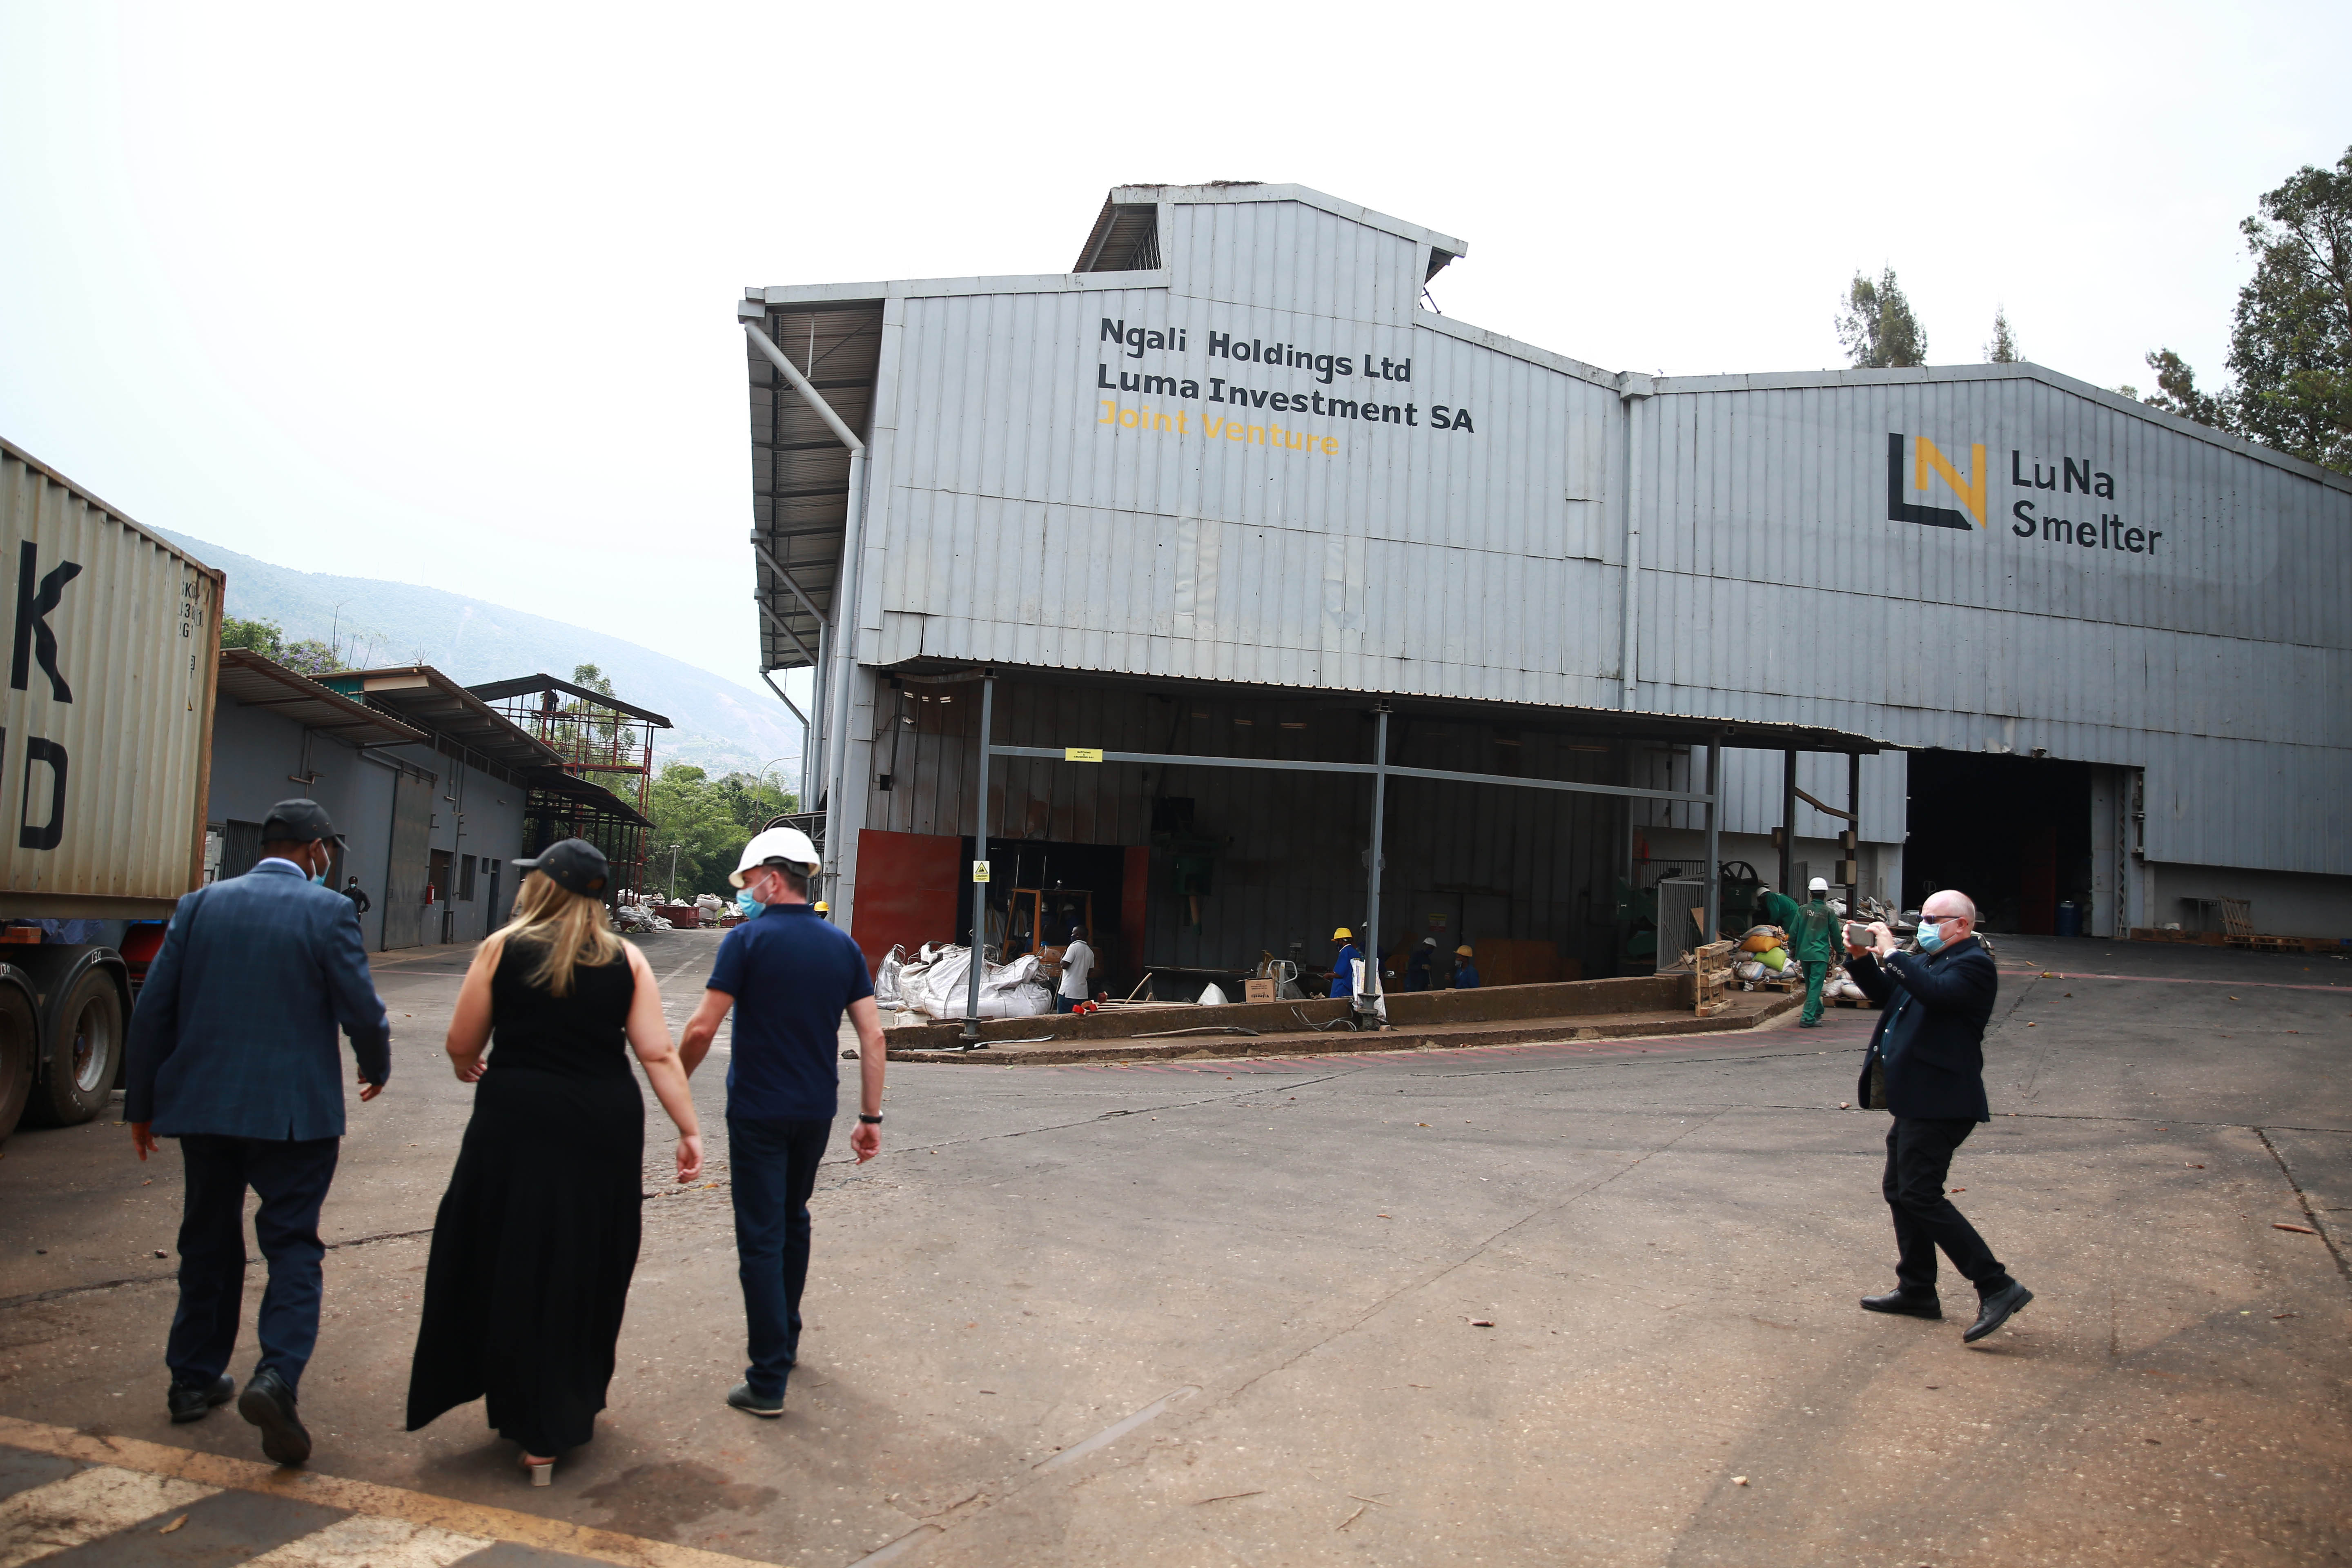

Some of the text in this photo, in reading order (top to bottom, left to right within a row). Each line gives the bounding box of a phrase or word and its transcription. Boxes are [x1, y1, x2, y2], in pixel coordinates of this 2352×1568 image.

[1101, 318, 1411, 384] Ngali Holdings Ltd
[1098, 363, 1474, 433] Luma Investment SA
[1098, 400, 1339, 455] Joint Venture
[2012, 450, 2114, 500] LuNa
[2011, 500, 2163, 555] Smelter
